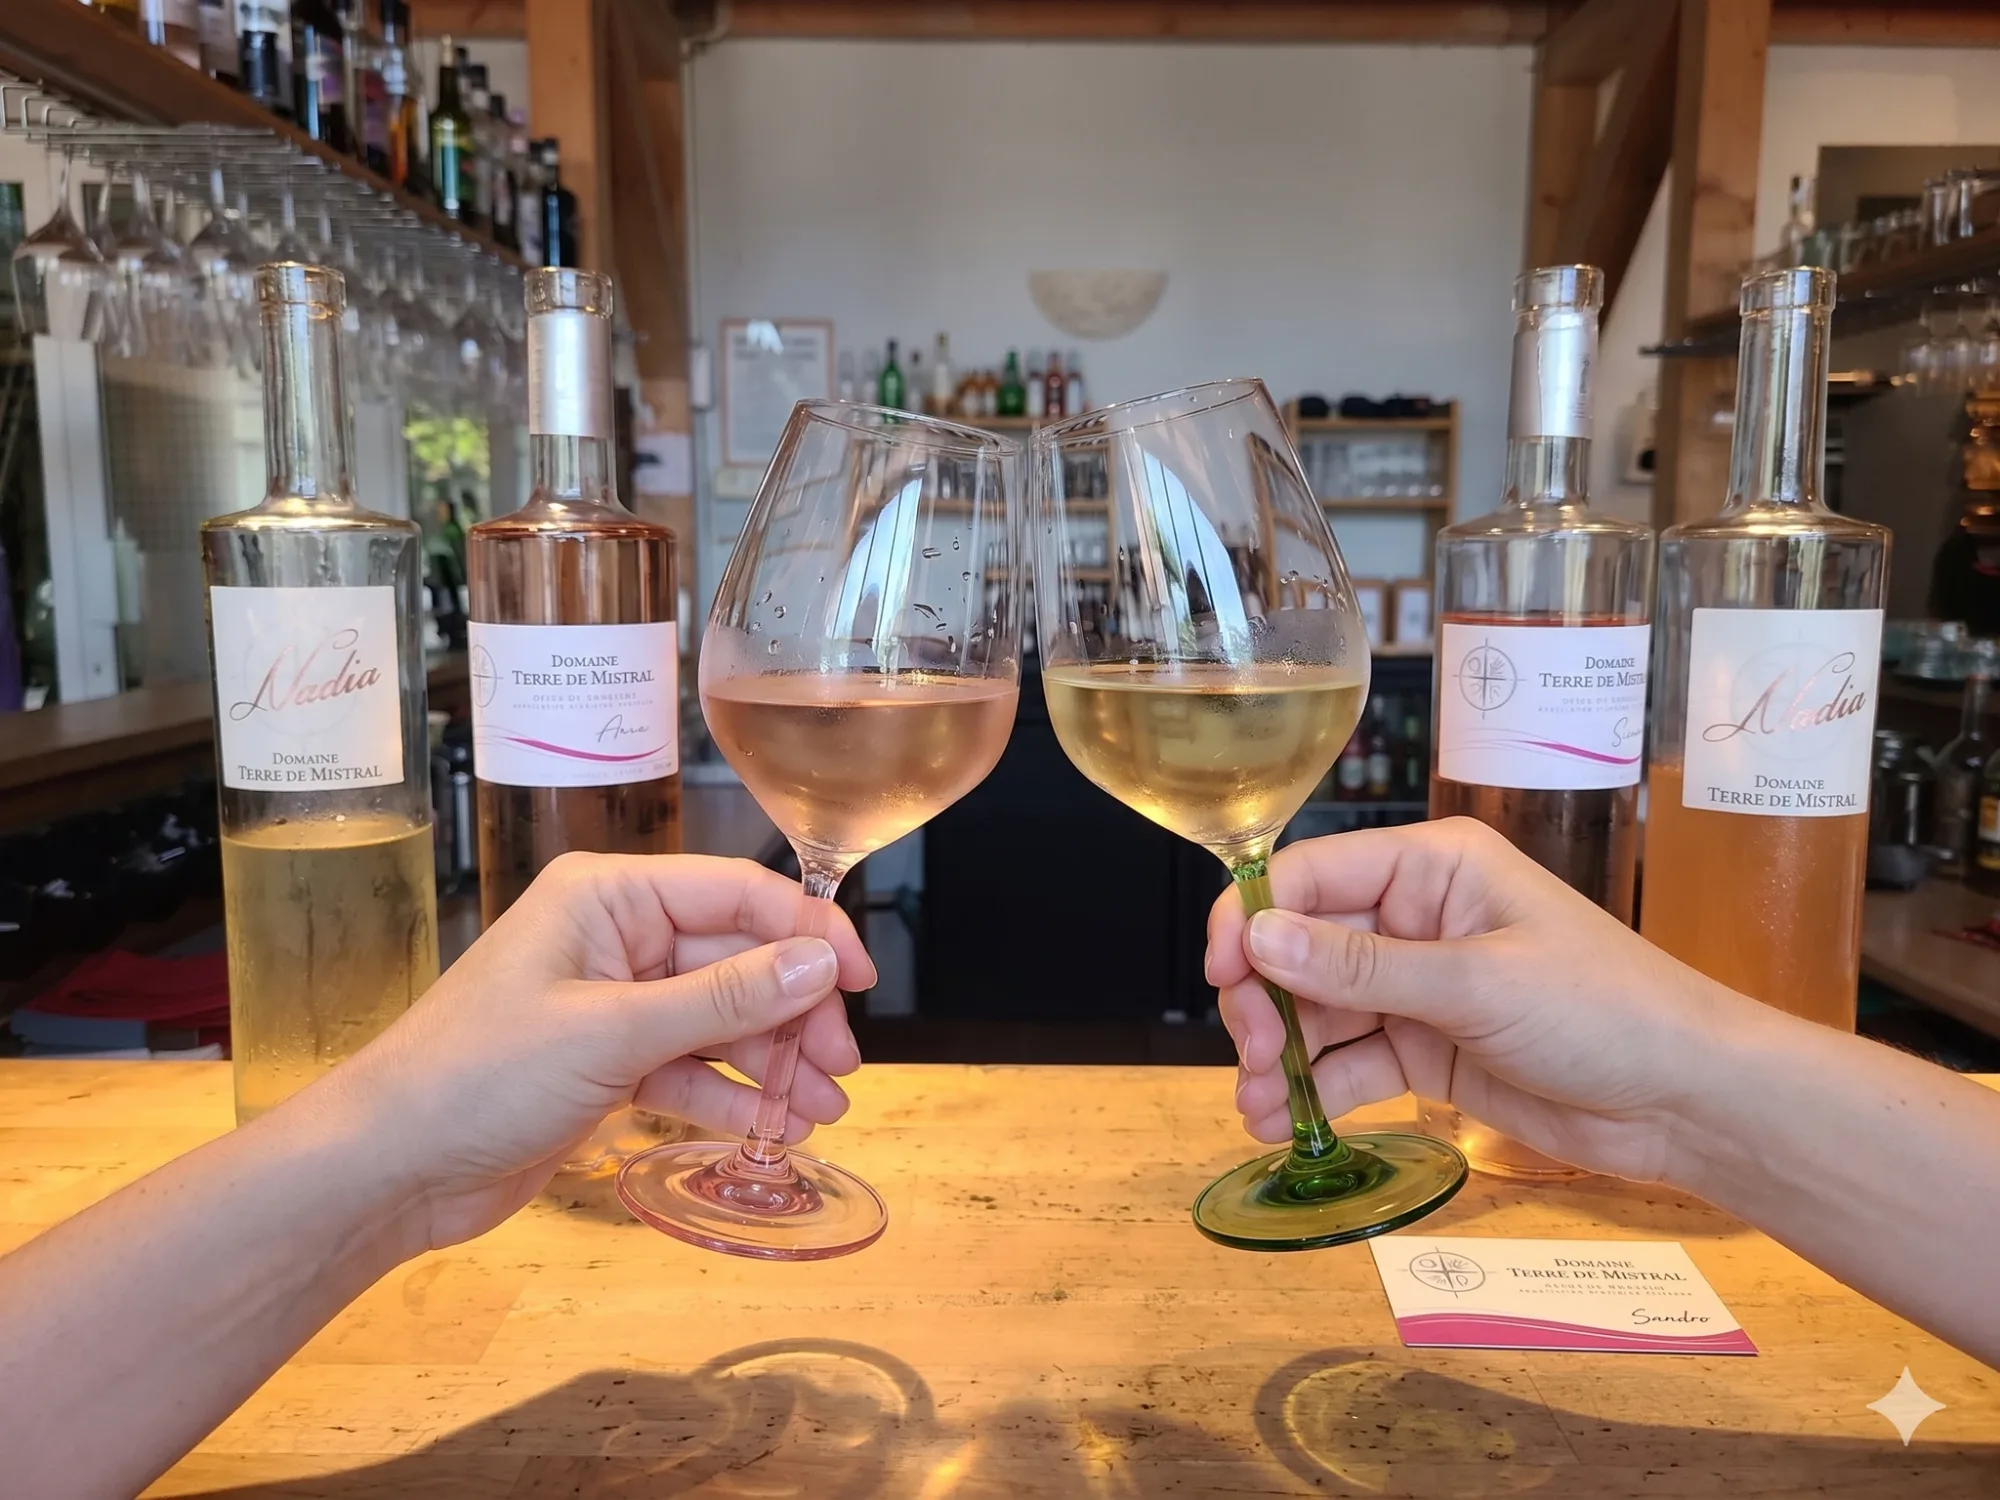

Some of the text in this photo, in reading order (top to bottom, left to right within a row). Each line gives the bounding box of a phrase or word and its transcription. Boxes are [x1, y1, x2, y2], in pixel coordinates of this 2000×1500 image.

[551, 654, 619, 668] DOMAINE
[1584, 656, 1636, 669] DOMAINE
[229, 628, 381, 721] Nadia
[511, 669, 655, 686] TERRE DE MISTRAL
[1538, 672, 1594, 688] TERRE
[1596, 675, 1614, 688] DE
[1702, 652, 1867, 743] Nadia
[272, 752, 339, 765] DOMAINE
[238, 765, 383, 782] TERRE DE MISTRAL
[1754, 774, 1825, 790] DOMAINE
[1707, 786, 1858, 808] TERRE DE MISTRAL
[1554, 1258, 1635, 1269] DOMAINE
[1506, 1267, 1687, 1281] TERRE DE MISTRAL
[1631, 1308, 1711, 1325] Sandro
